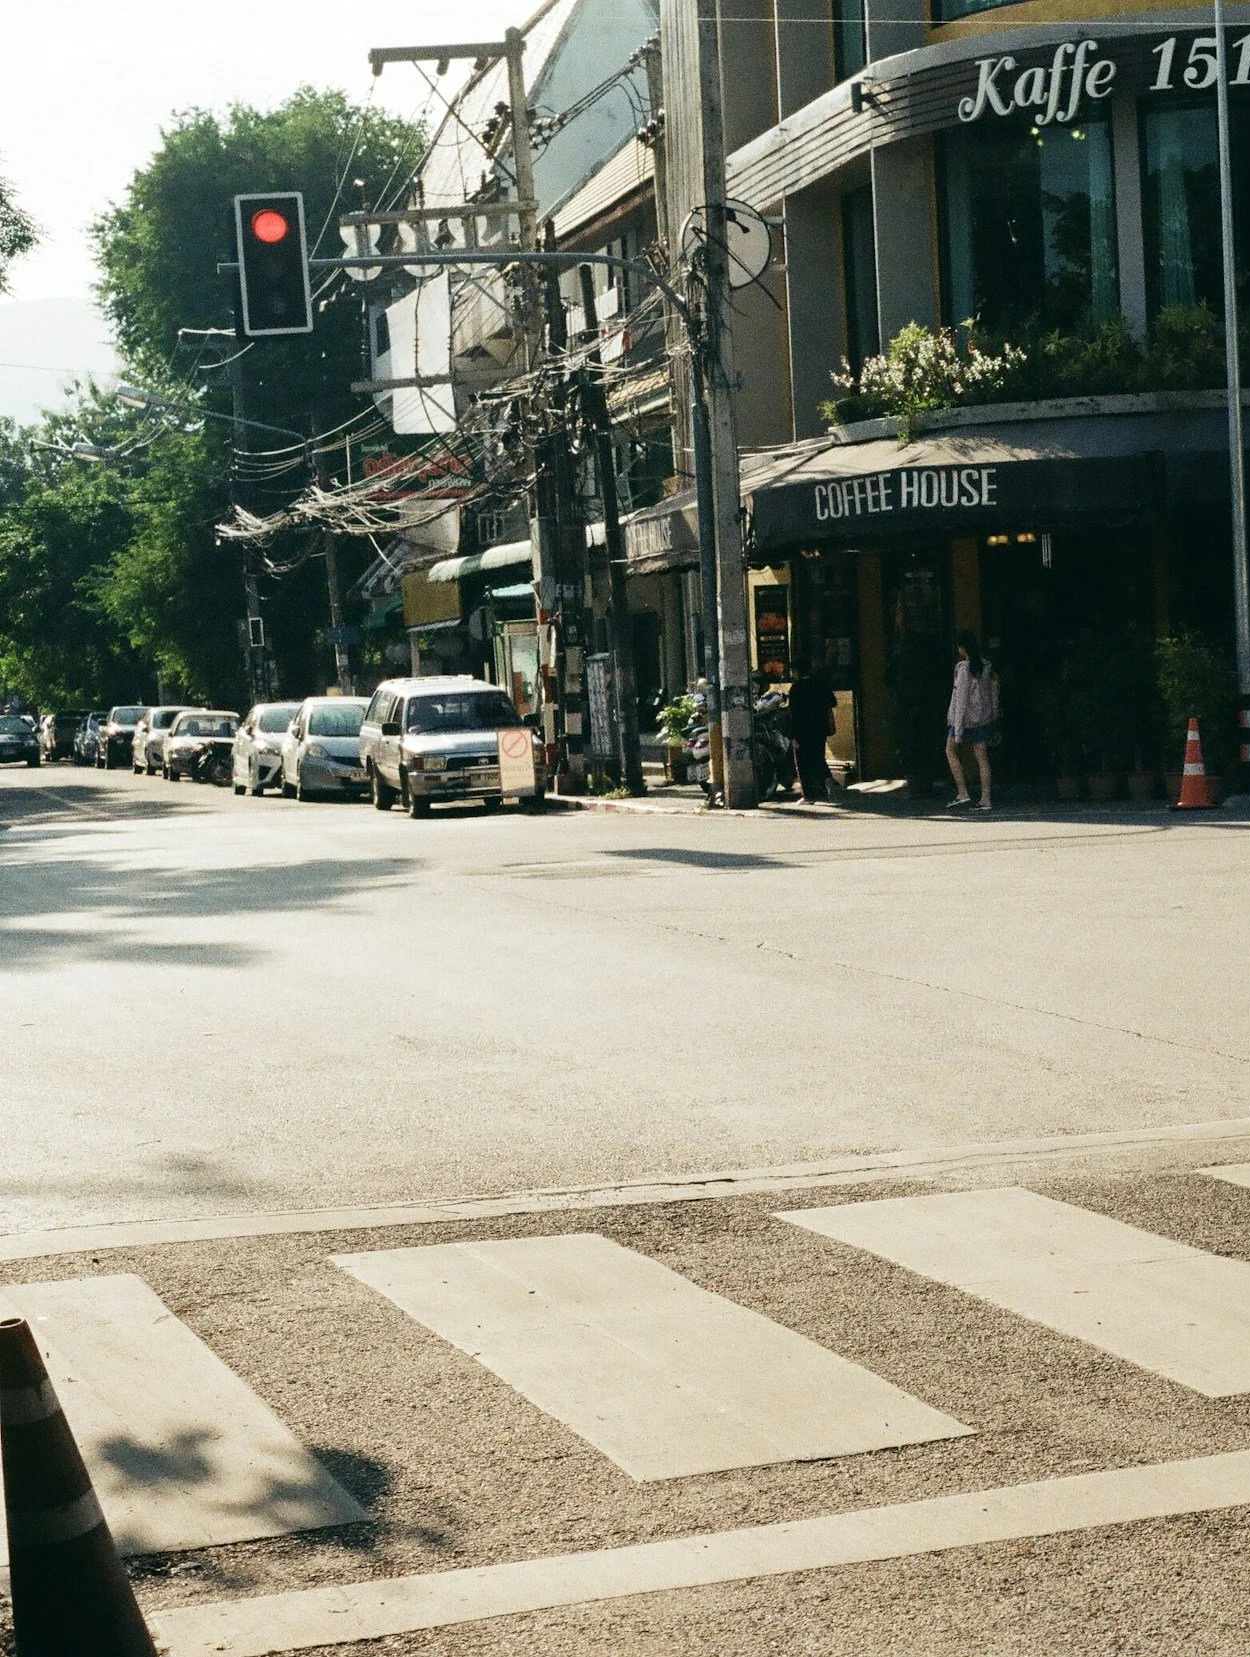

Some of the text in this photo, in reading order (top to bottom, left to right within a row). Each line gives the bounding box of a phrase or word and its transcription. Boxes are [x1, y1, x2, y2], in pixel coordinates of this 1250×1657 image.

[957, 39, 1117, 126] Kaffe
[815, 469, 997, 521] COFFEE HOUSE
